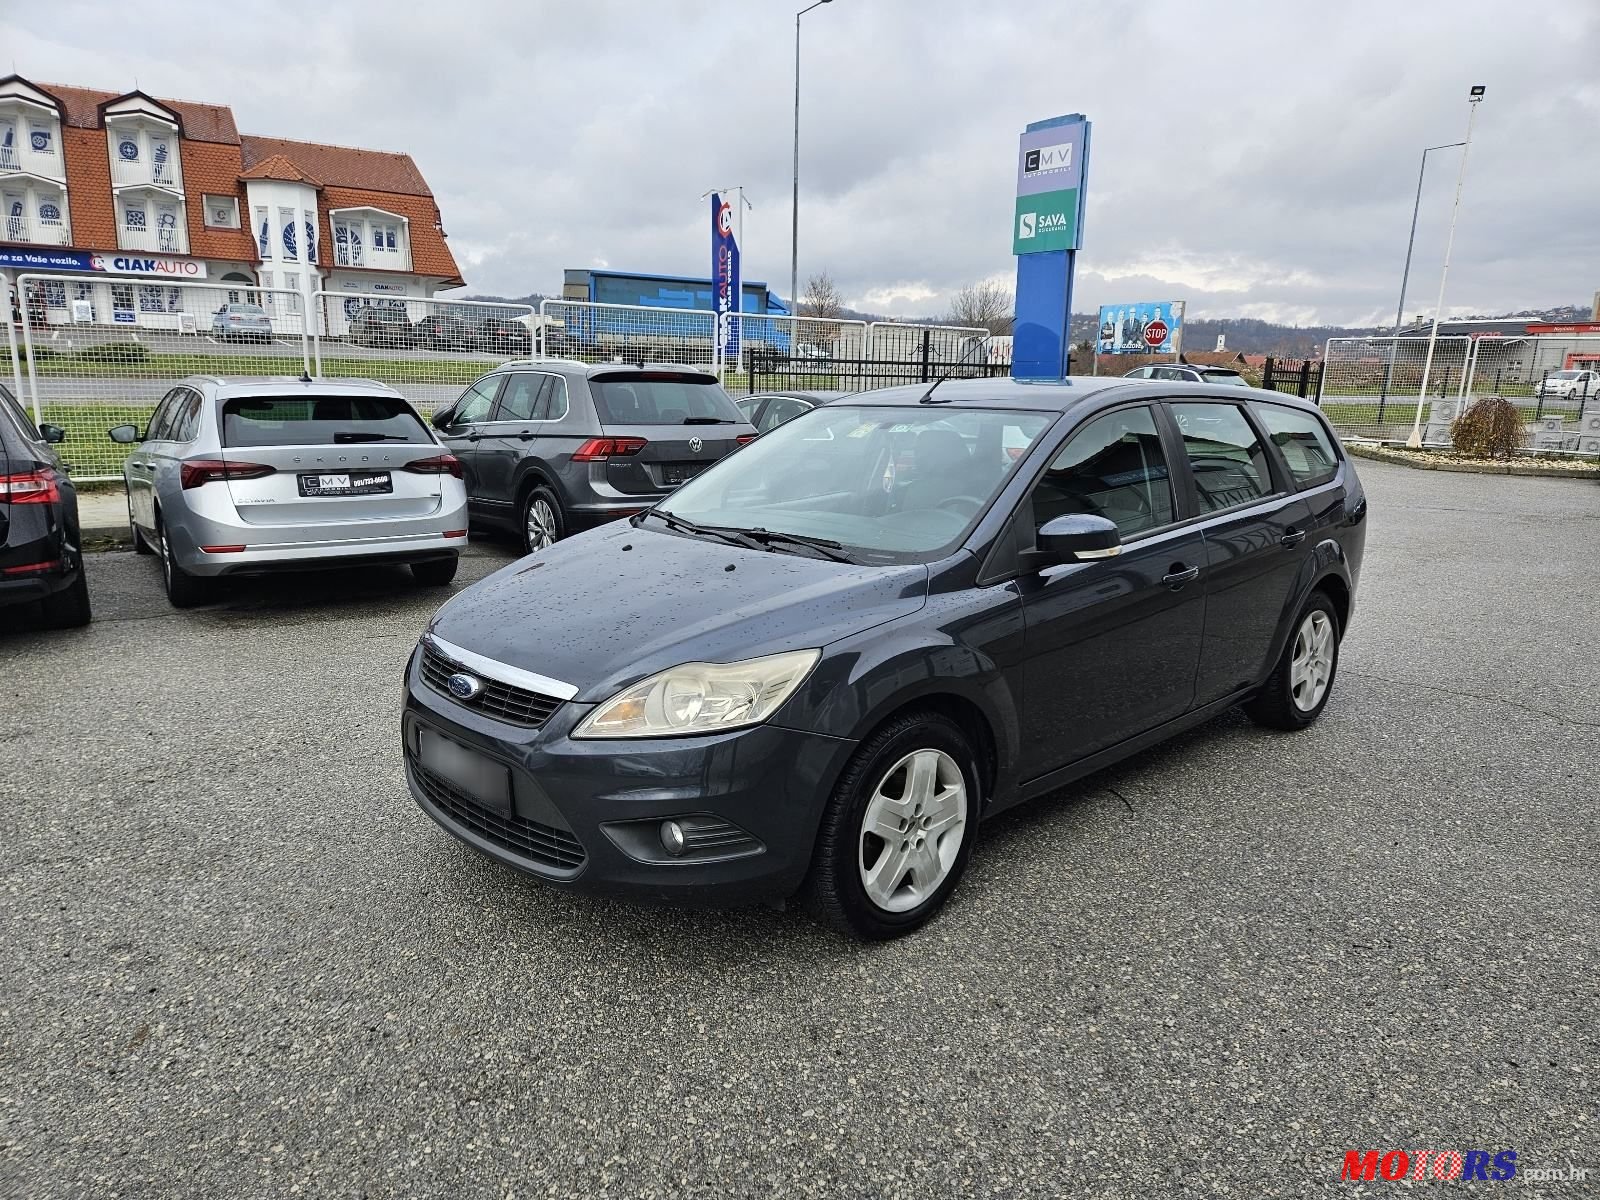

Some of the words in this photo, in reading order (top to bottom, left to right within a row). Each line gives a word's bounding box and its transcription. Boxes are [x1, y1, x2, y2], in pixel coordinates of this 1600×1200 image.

[1038, 212, 1067, 228] SAVA
[25, 254, 48, 264] Vaše
[1146, 328, 1167, 339] STOP
